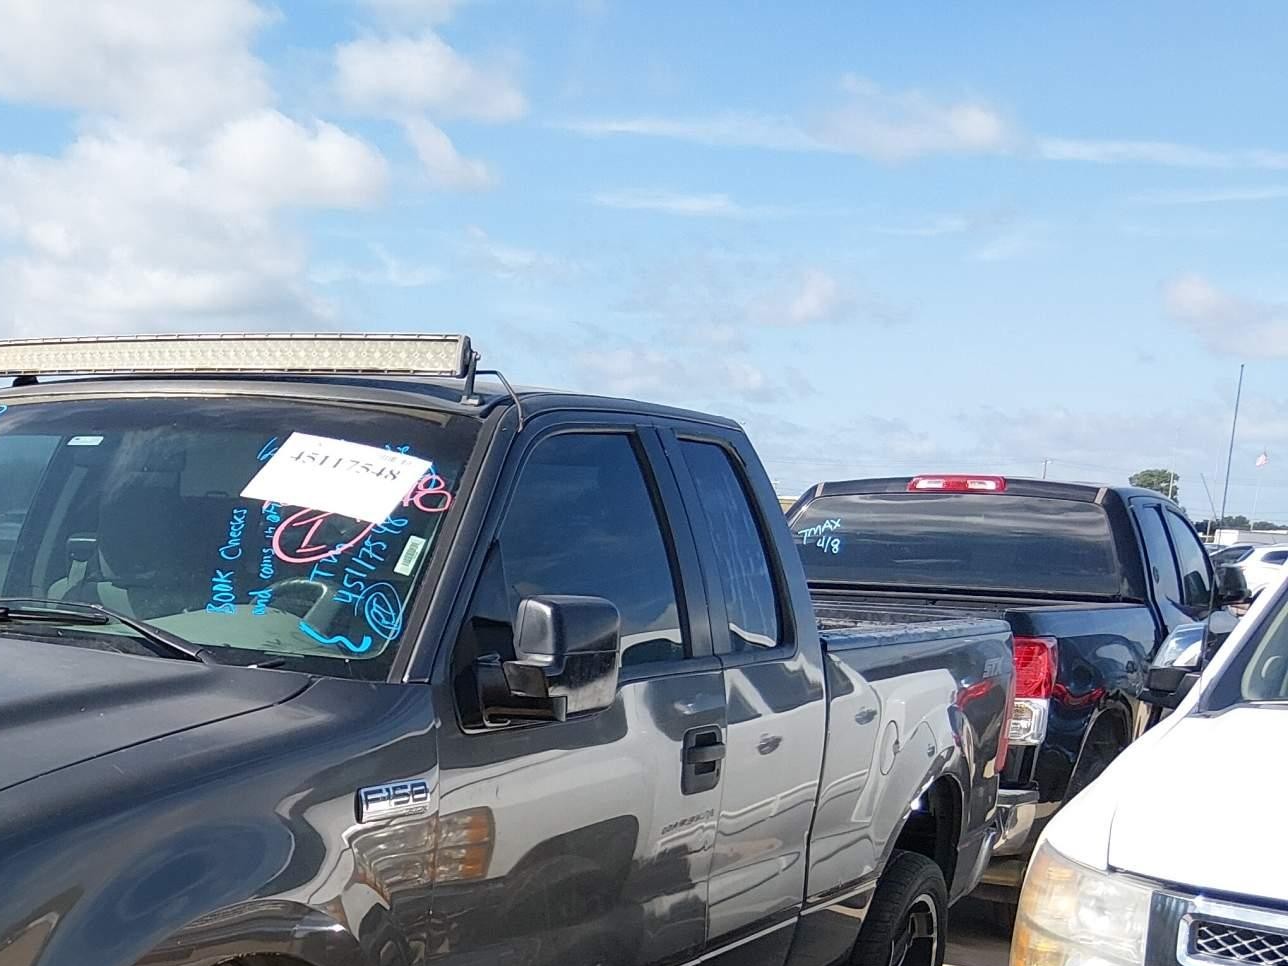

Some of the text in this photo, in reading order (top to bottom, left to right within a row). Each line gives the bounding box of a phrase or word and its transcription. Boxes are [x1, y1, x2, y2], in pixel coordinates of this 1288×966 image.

[289, 449, 402, 482] 45117548
[797, 518, 841, 545] TMAX
[816, 535, 841, 554] 4/8
